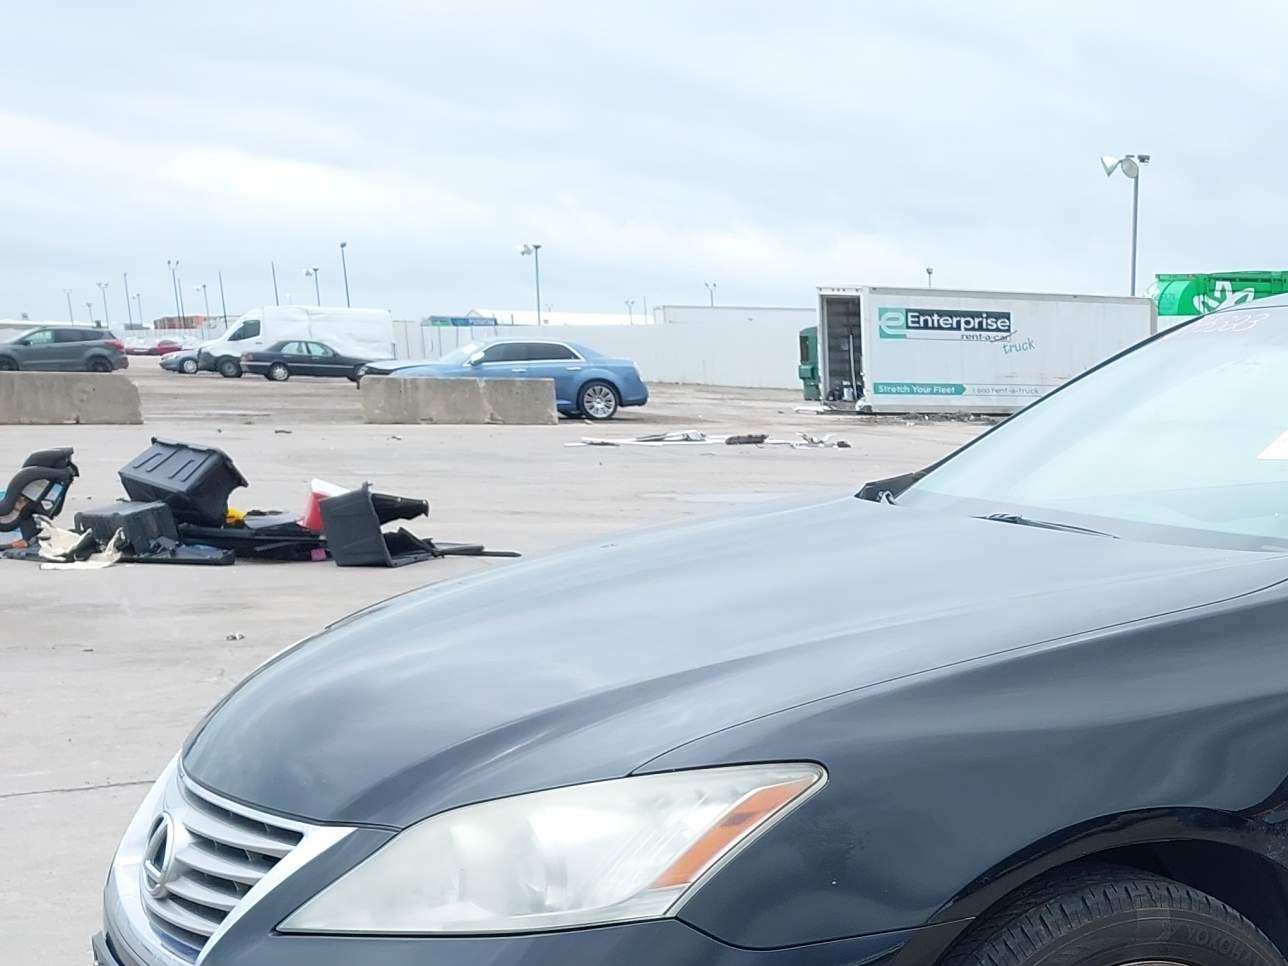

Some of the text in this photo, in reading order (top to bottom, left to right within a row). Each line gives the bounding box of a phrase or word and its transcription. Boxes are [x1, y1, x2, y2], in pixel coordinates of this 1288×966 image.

[907, 312, 1010, 331] Enterprise
[1002, 338, 1035, 354] truck
[877, 384, 911, 393] Stretch
[912, 385, 932, 393] Your
